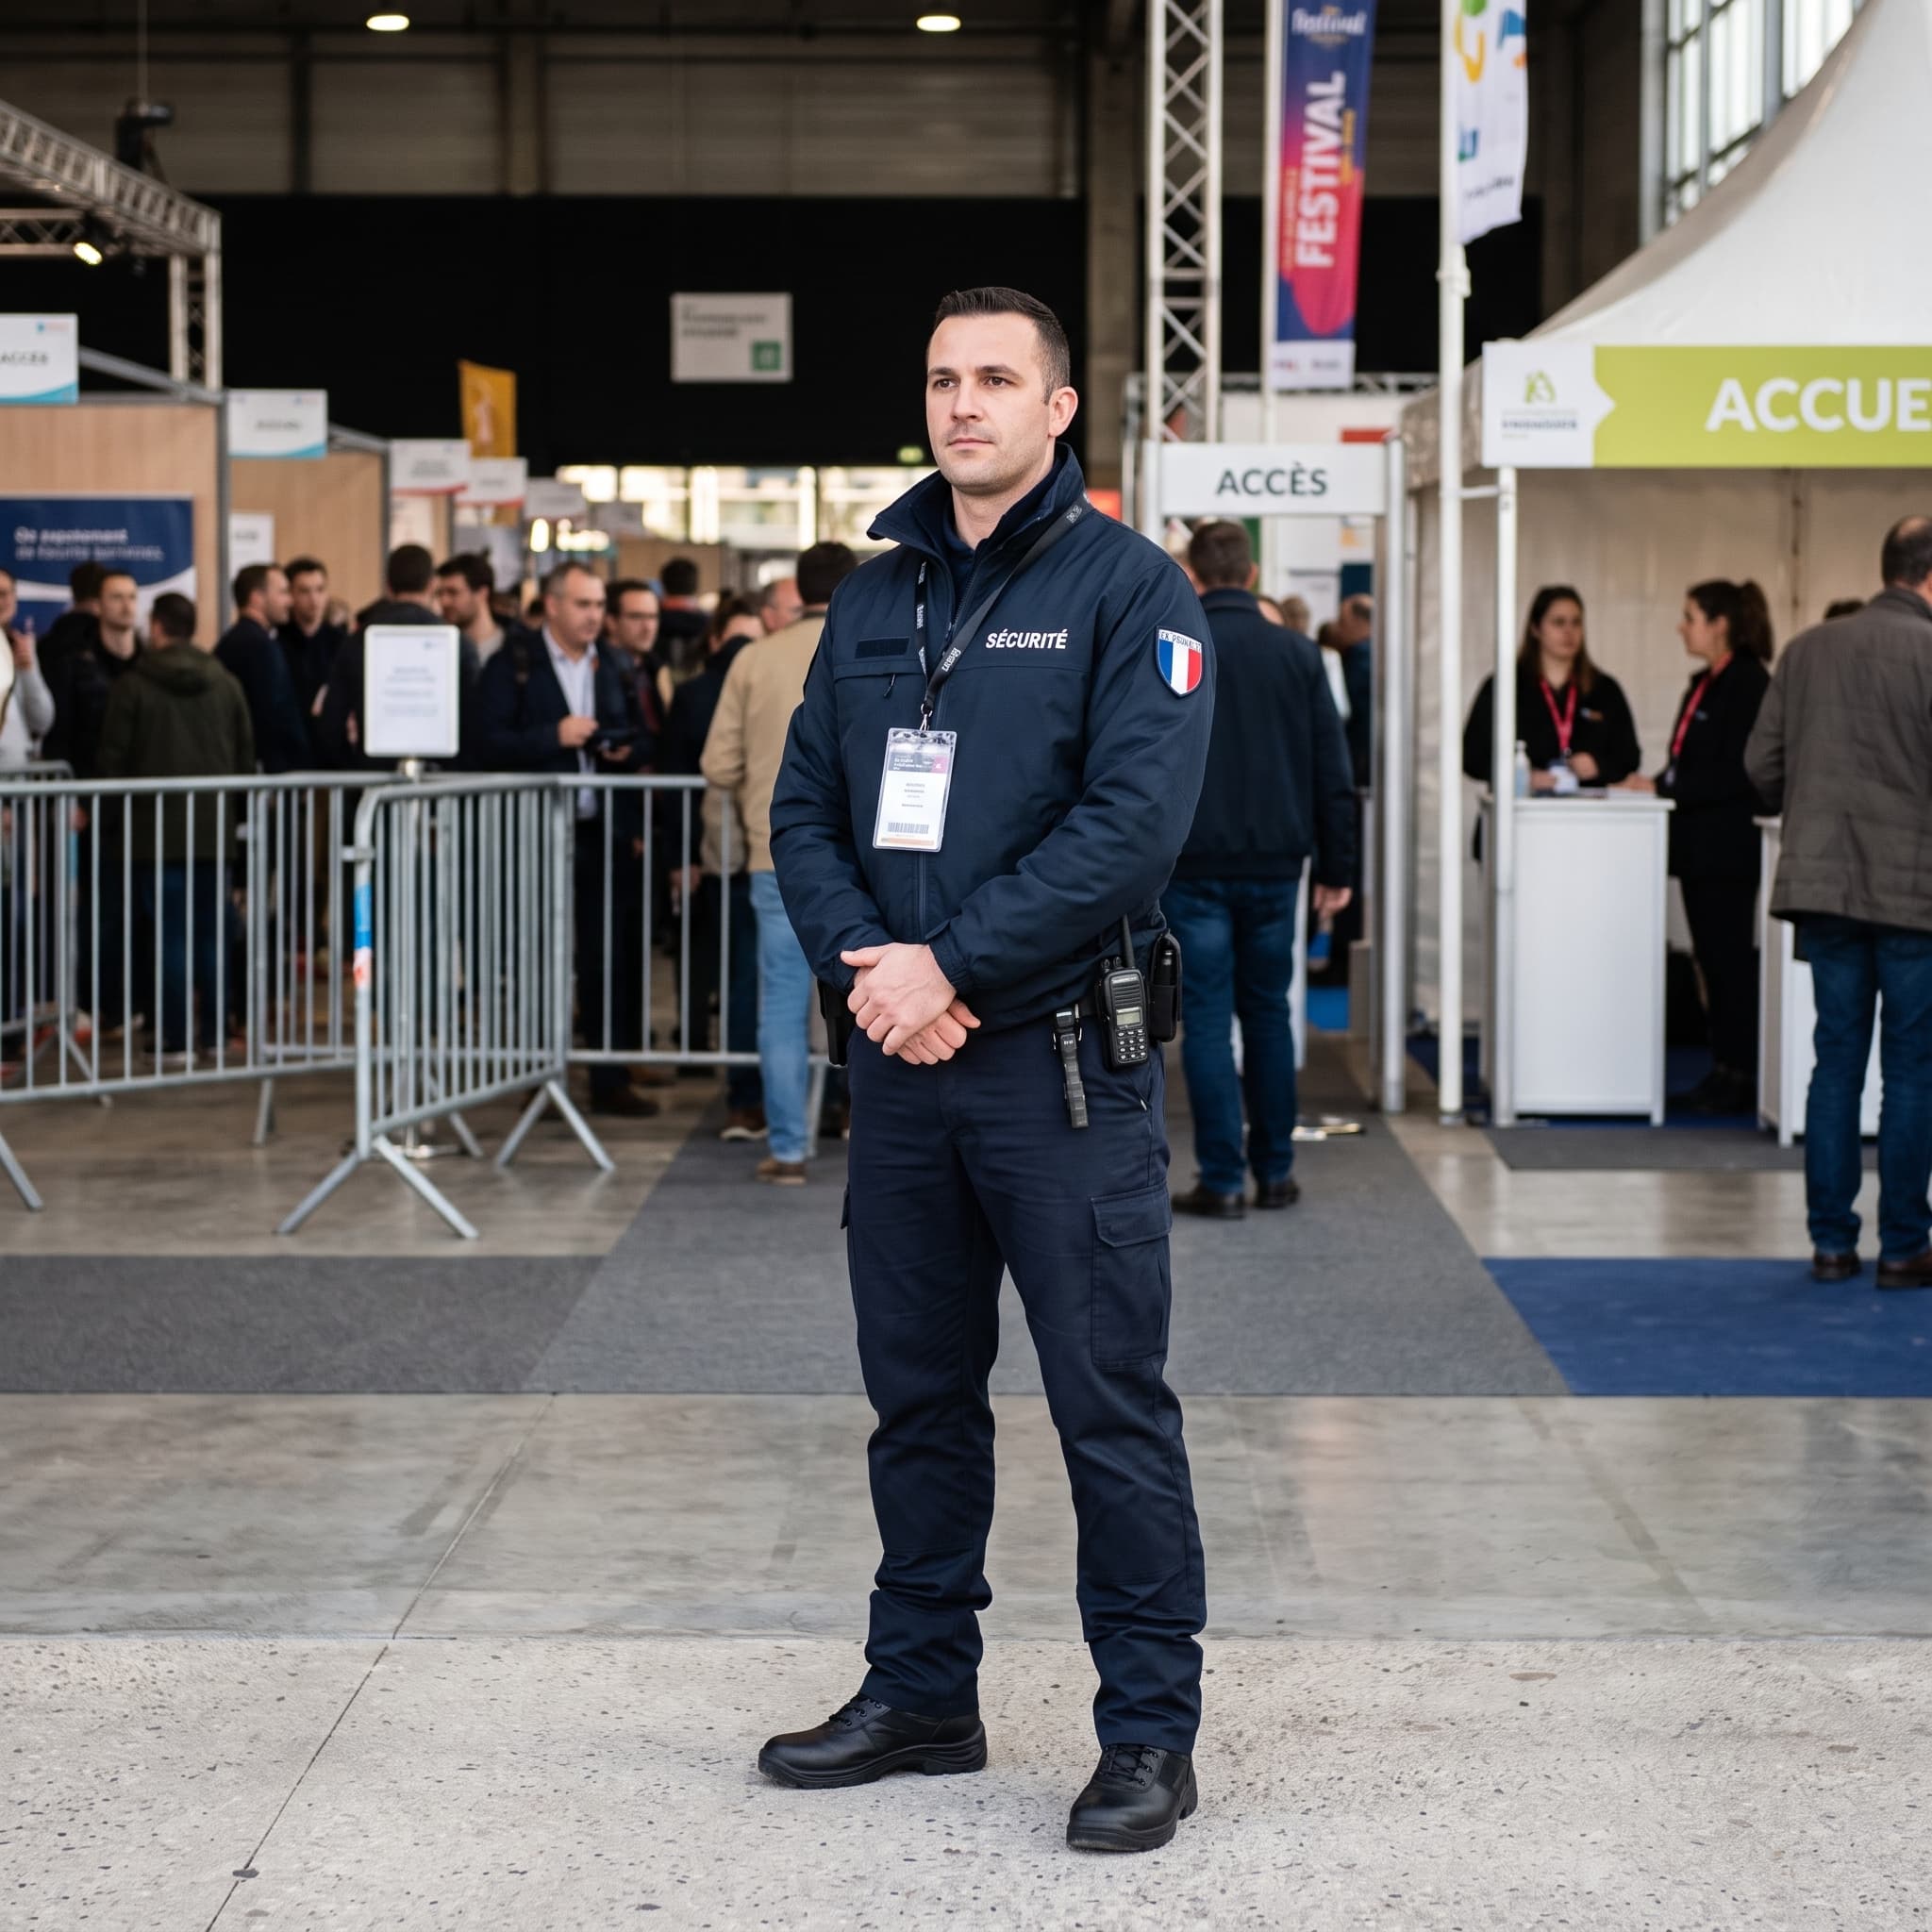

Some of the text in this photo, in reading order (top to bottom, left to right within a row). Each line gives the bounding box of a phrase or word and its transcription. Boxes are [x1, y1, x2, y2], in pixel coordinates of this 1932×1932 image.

[1295, 71, 1346, 268] FESTIVAL
[1705, 376, 1932, 432] ACCUE
[1215, 459, 1328, 496] ACCÈS
[985, 628, 1068, 650] SÉCURITÉ
